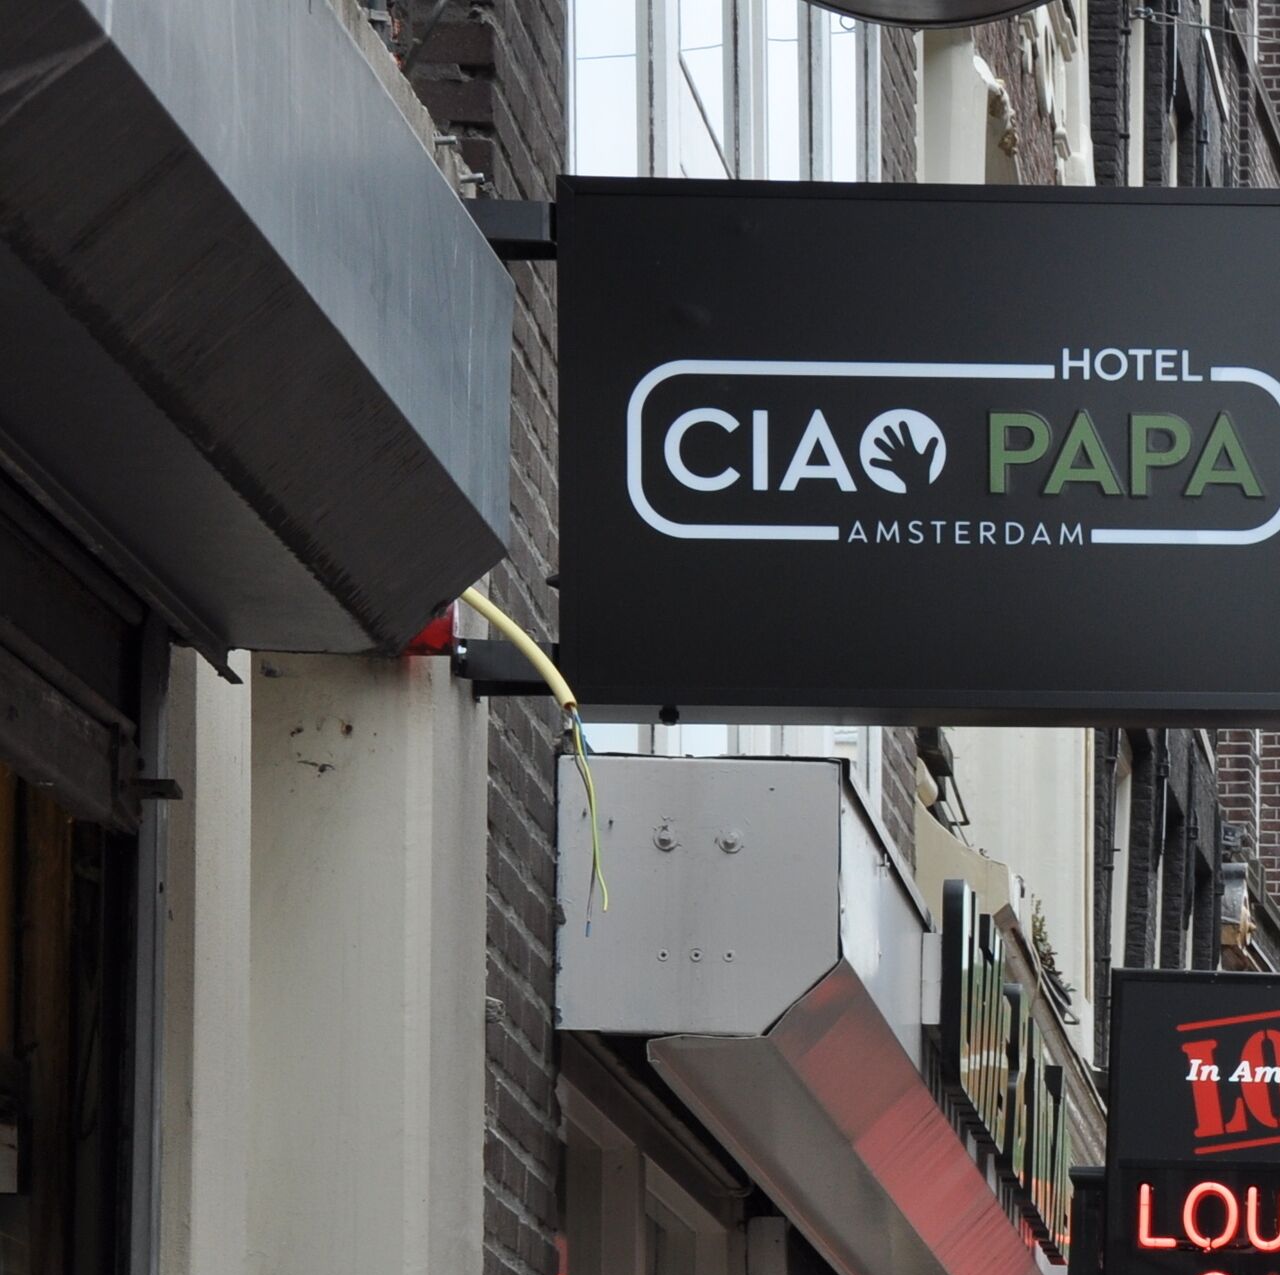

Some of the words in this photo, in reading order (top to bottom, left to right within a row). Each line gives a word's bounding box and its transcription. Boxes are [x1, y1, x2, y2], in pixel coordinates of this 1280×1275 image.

[1062, 348, 1203, 382] HOTEL
[663, 407, 947, 494] CIAO
[989, 409, 1264, 498] PAPA
[847, 519, 1084, 546] AMSTERDAM
[1185, 1058, 1221, 1082] In
